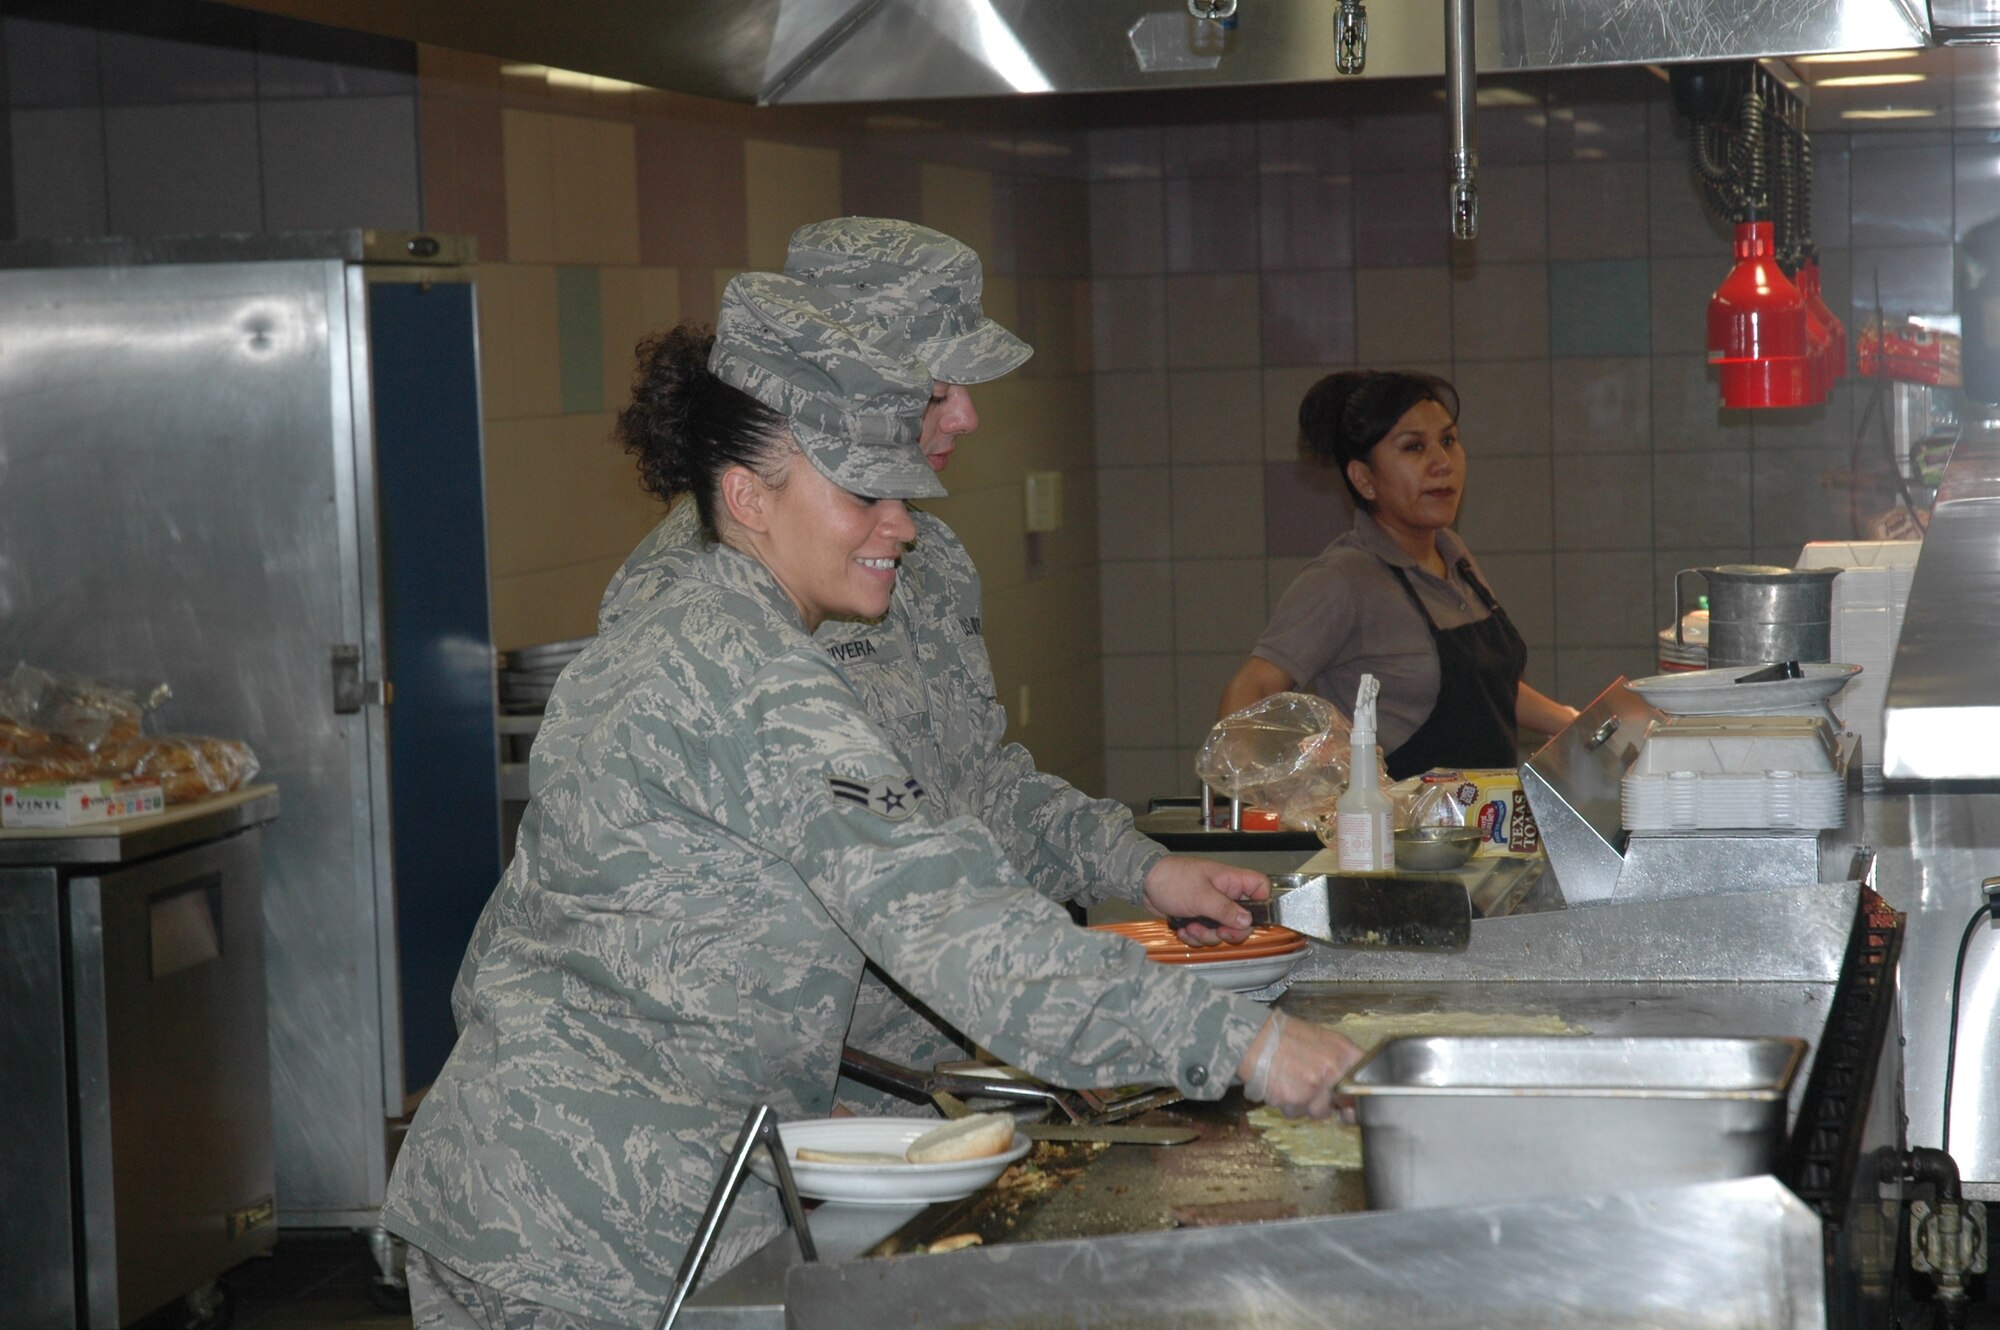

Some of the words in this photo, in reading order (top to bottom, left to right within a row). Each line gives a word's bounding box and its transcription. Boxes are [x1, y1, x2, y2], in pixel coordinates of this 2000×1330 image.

[826, 638, 877, 662] IVERA
[16, 800, 62, 811] VINYL
[1511, 795, 1526, 849] TEXAS
